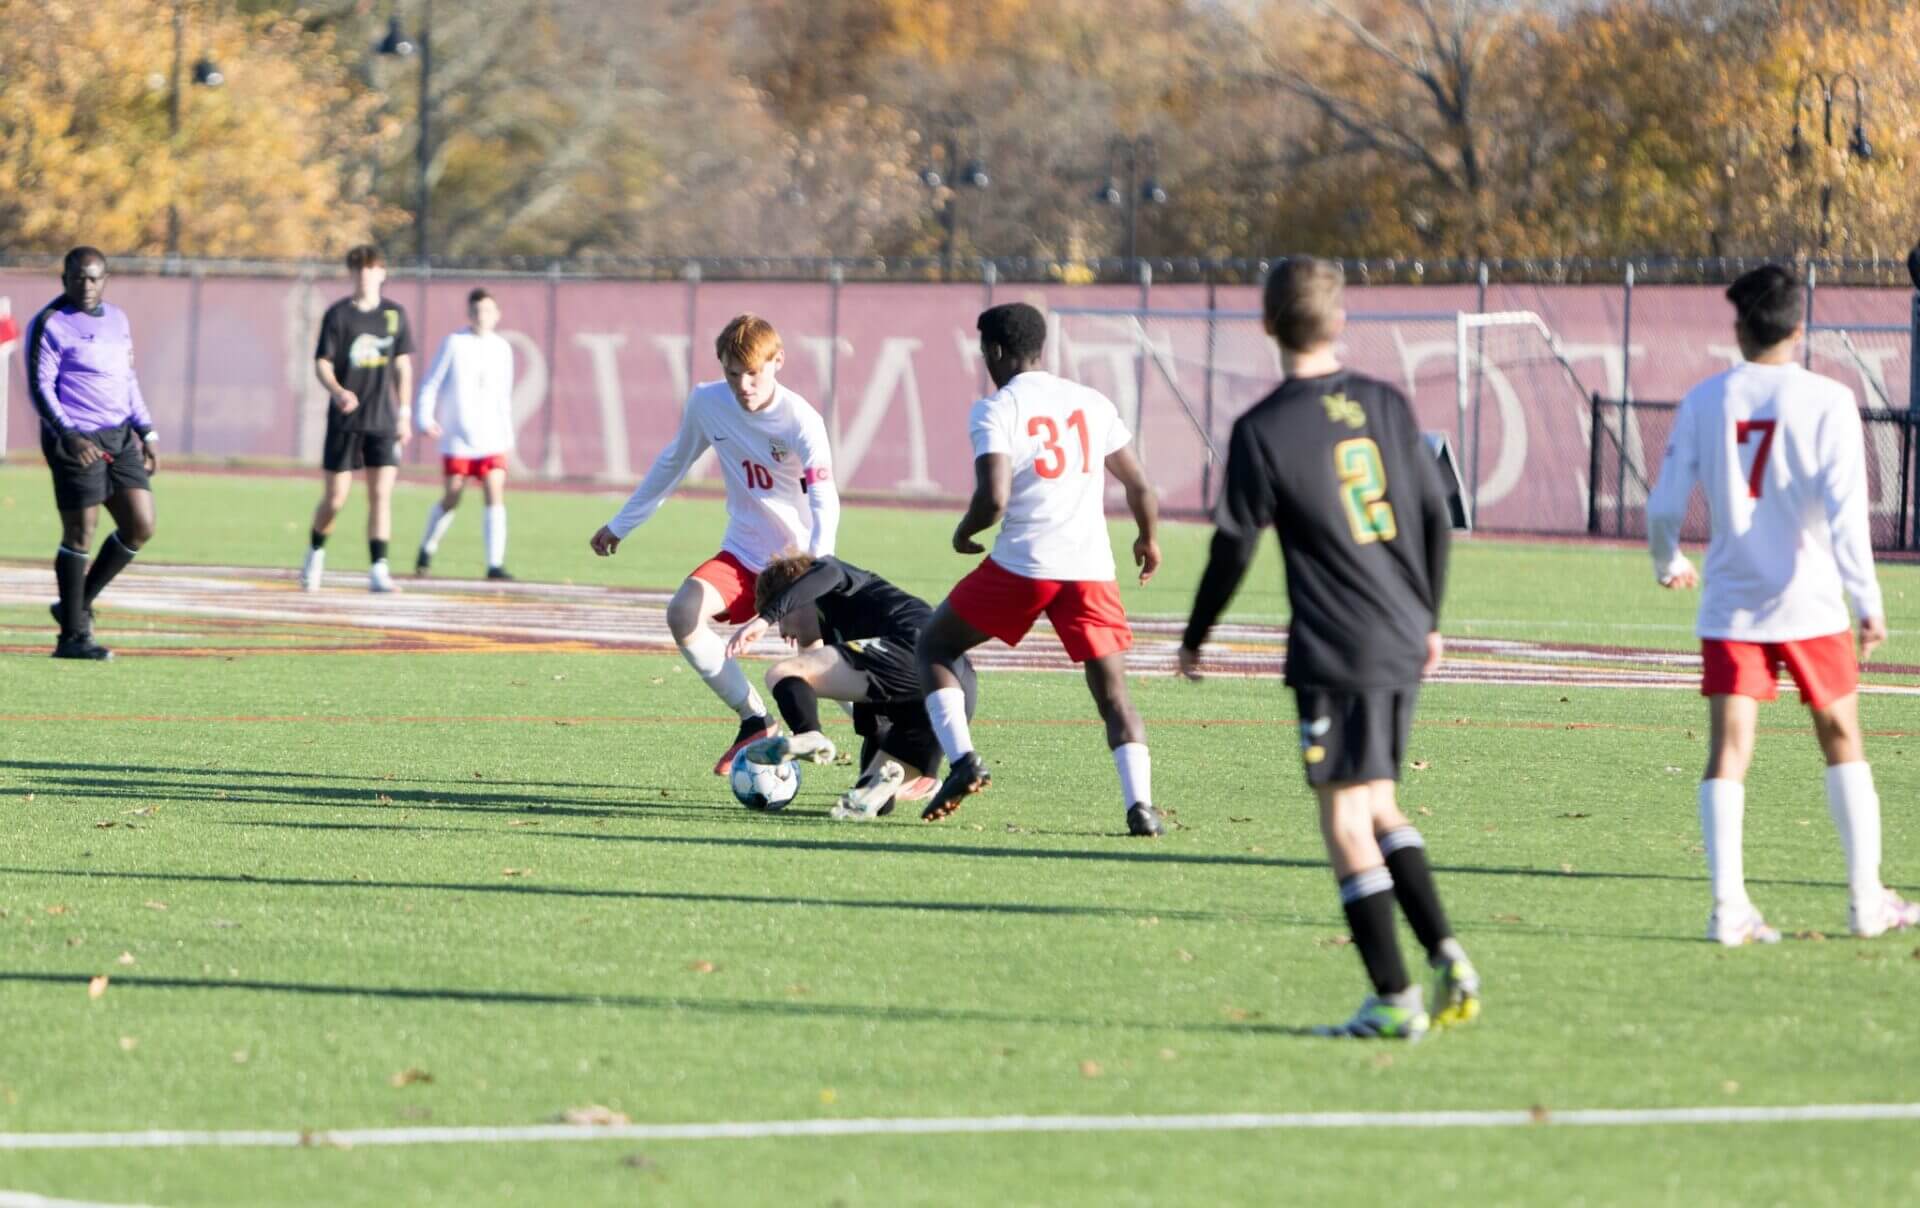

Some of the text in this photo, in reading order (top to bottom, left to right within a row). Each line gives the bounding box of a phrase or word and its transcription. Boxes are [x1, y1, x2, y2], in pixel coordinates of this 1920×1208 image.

[742, 460, 774, 490] 10
[816, 467, 829, 481] C
[1028, 410, 1089, 478] 31
[1737, 420, 1776, 498] 7
[1334, 438, 1397, 544] 2
